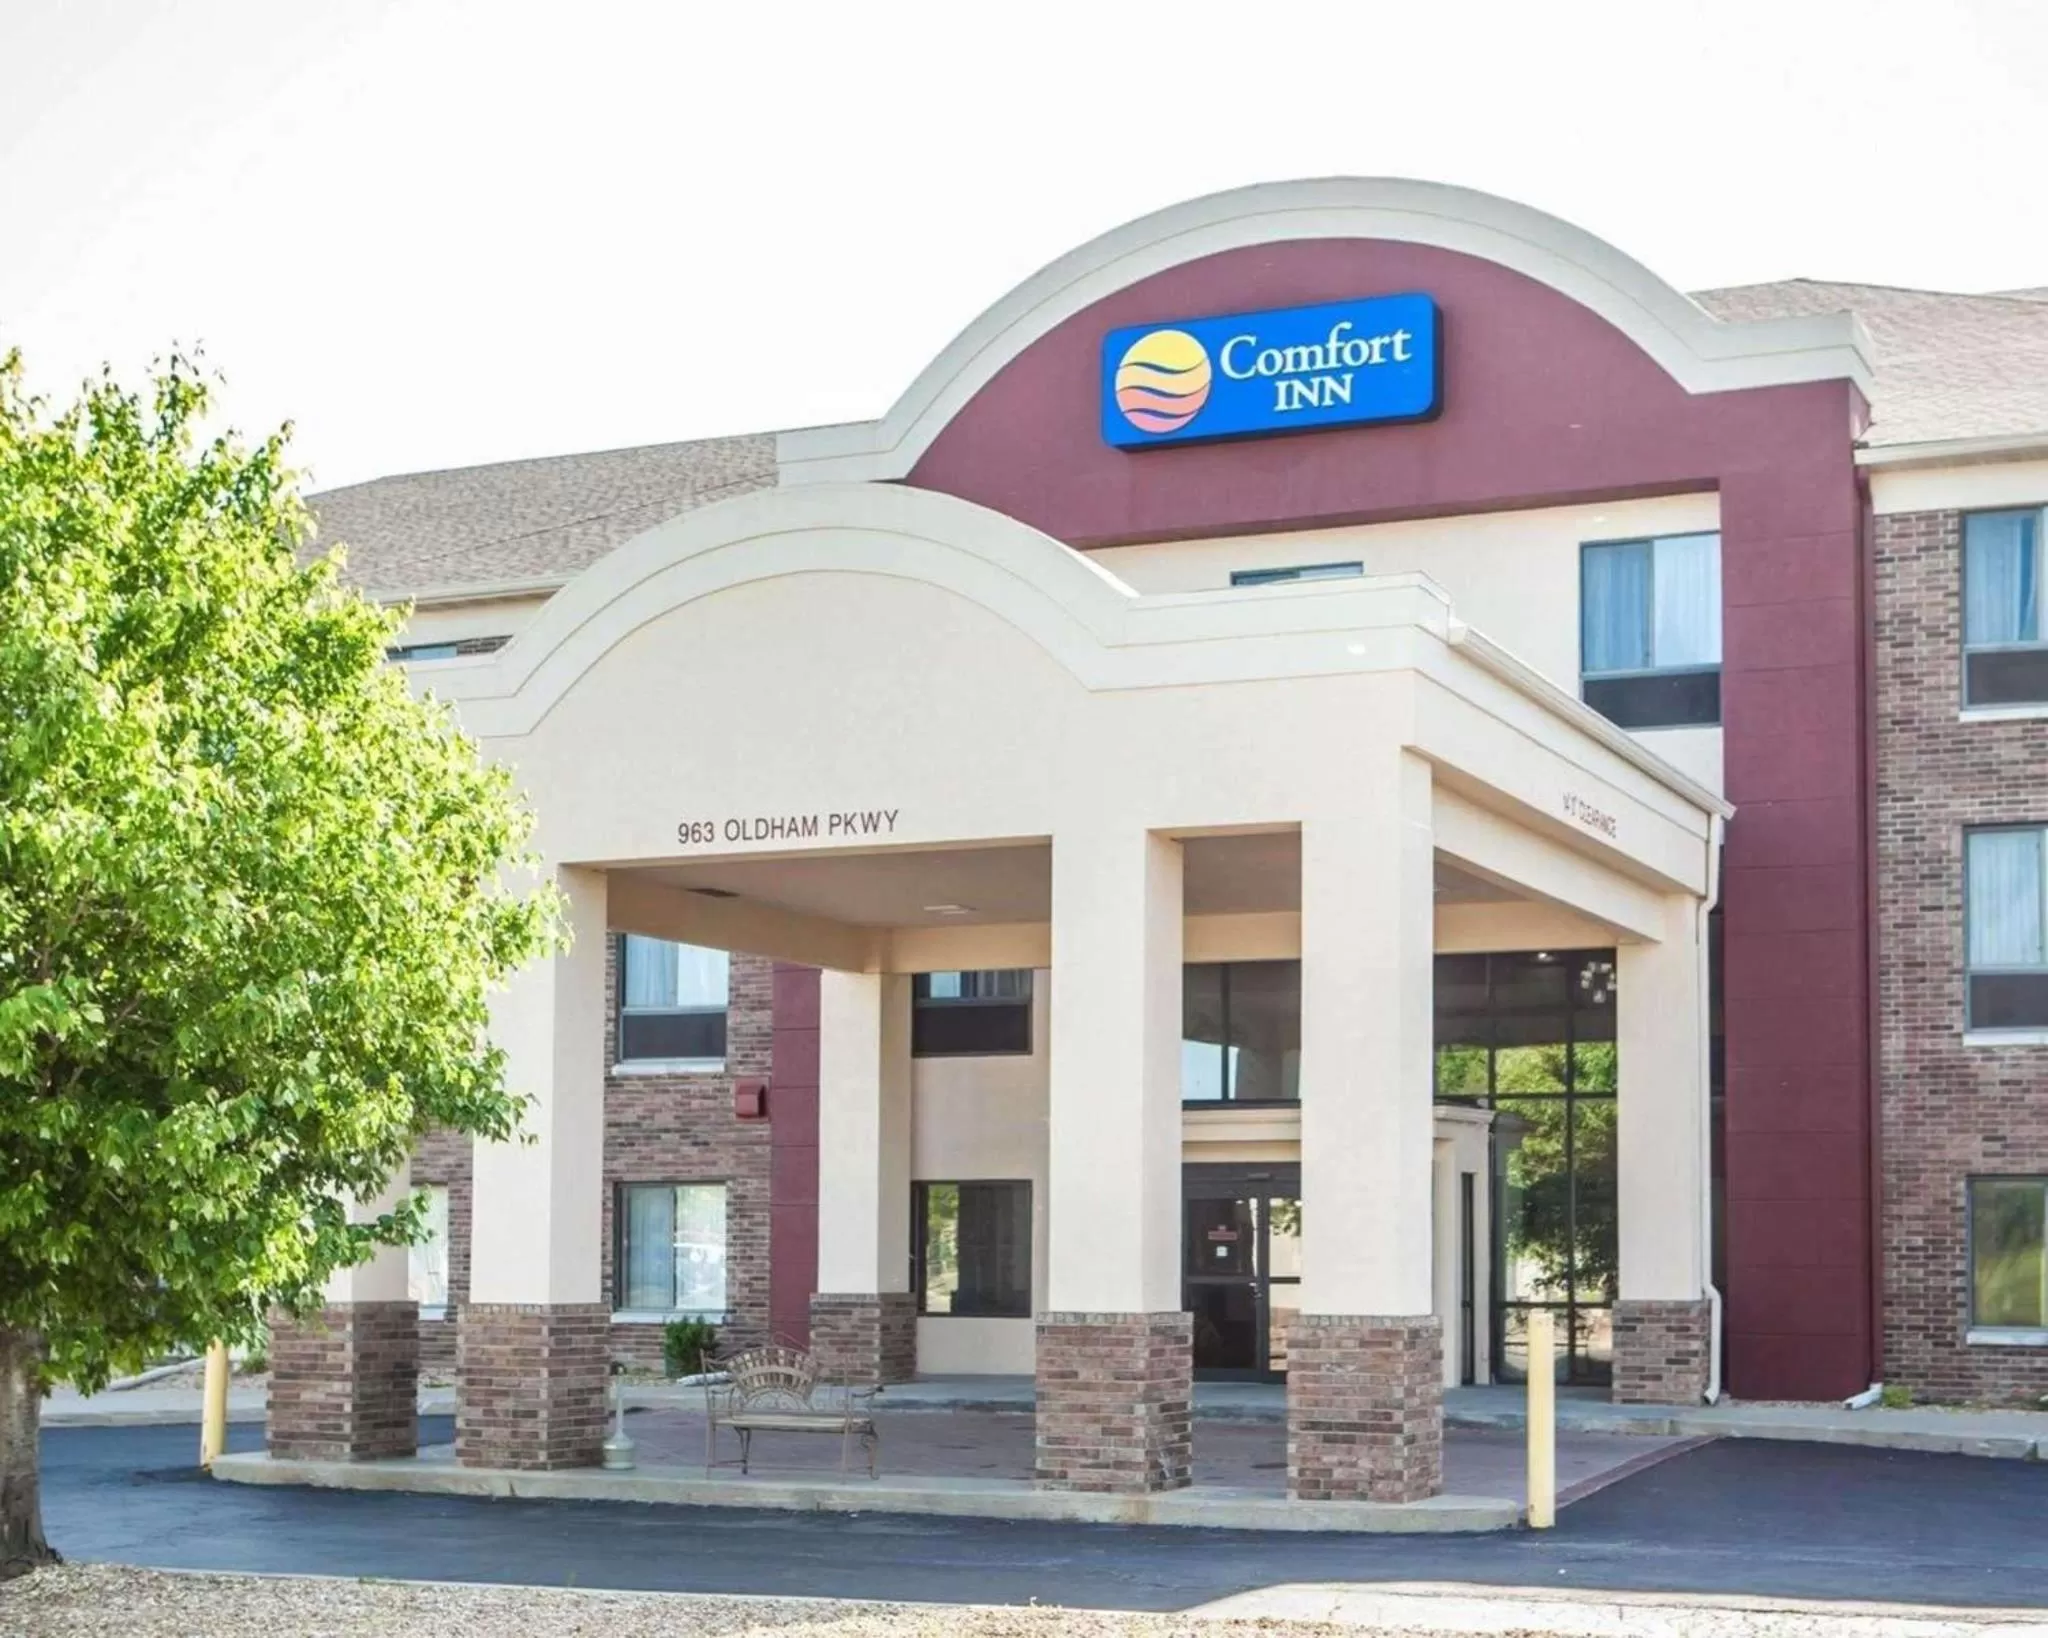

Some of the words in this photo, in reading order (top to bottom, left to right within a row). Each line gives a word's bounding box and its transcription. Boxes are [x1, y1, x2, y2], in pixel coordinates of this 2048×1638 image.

[1220, 321, 1411, 379] Comfort
[1274, 374, 1353, 411] INN
[678, 822, 715, 844] 963
[724, 816, 818, 842] OLDHAM
[828, 809, 899, 836] PKWY
